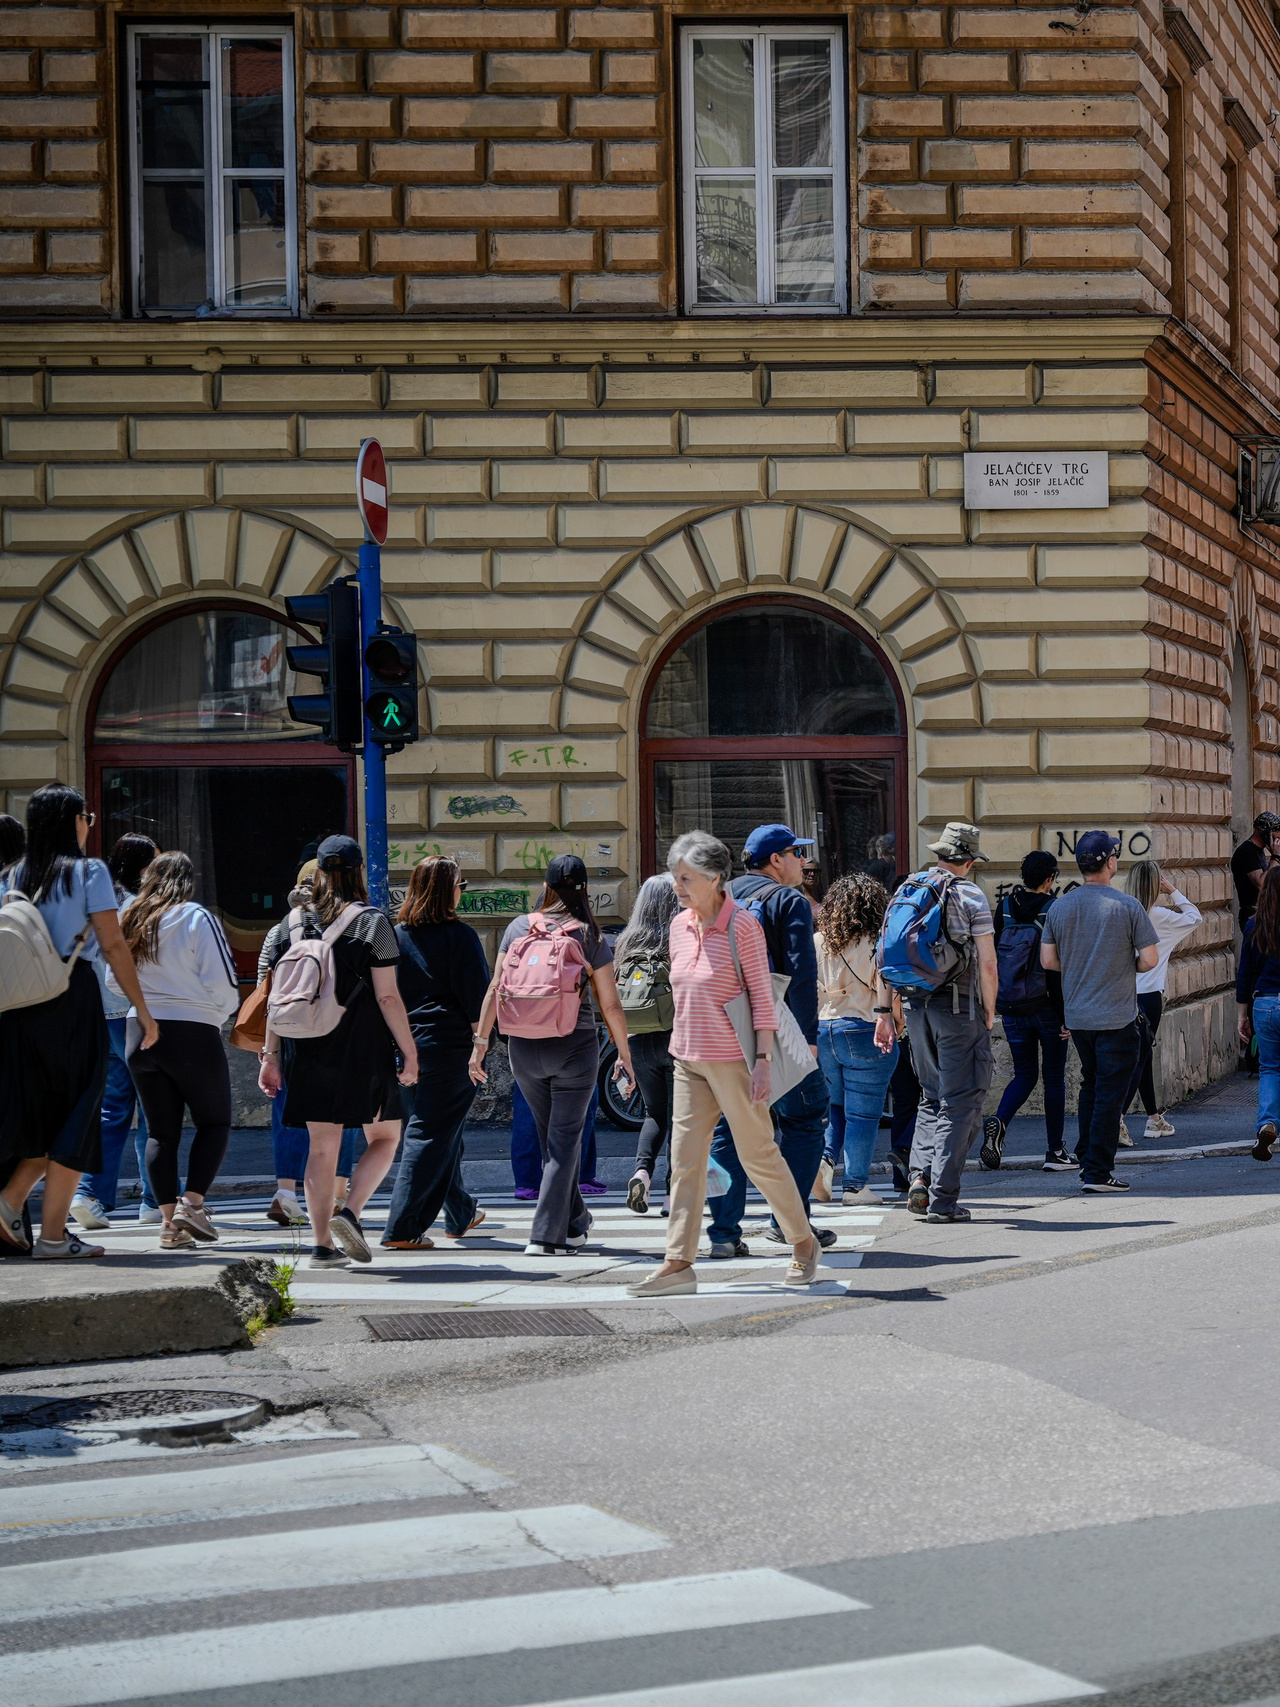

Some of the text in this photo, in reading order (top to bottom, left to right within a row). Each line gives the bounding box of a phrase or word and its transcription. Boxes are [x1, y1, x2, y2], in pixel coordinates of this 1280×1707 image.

[983, 462, 1089, 476] JELAČIĆEV TRG
[988, 476, 1085, 487] BAN JOSIP JELAČIĆ
